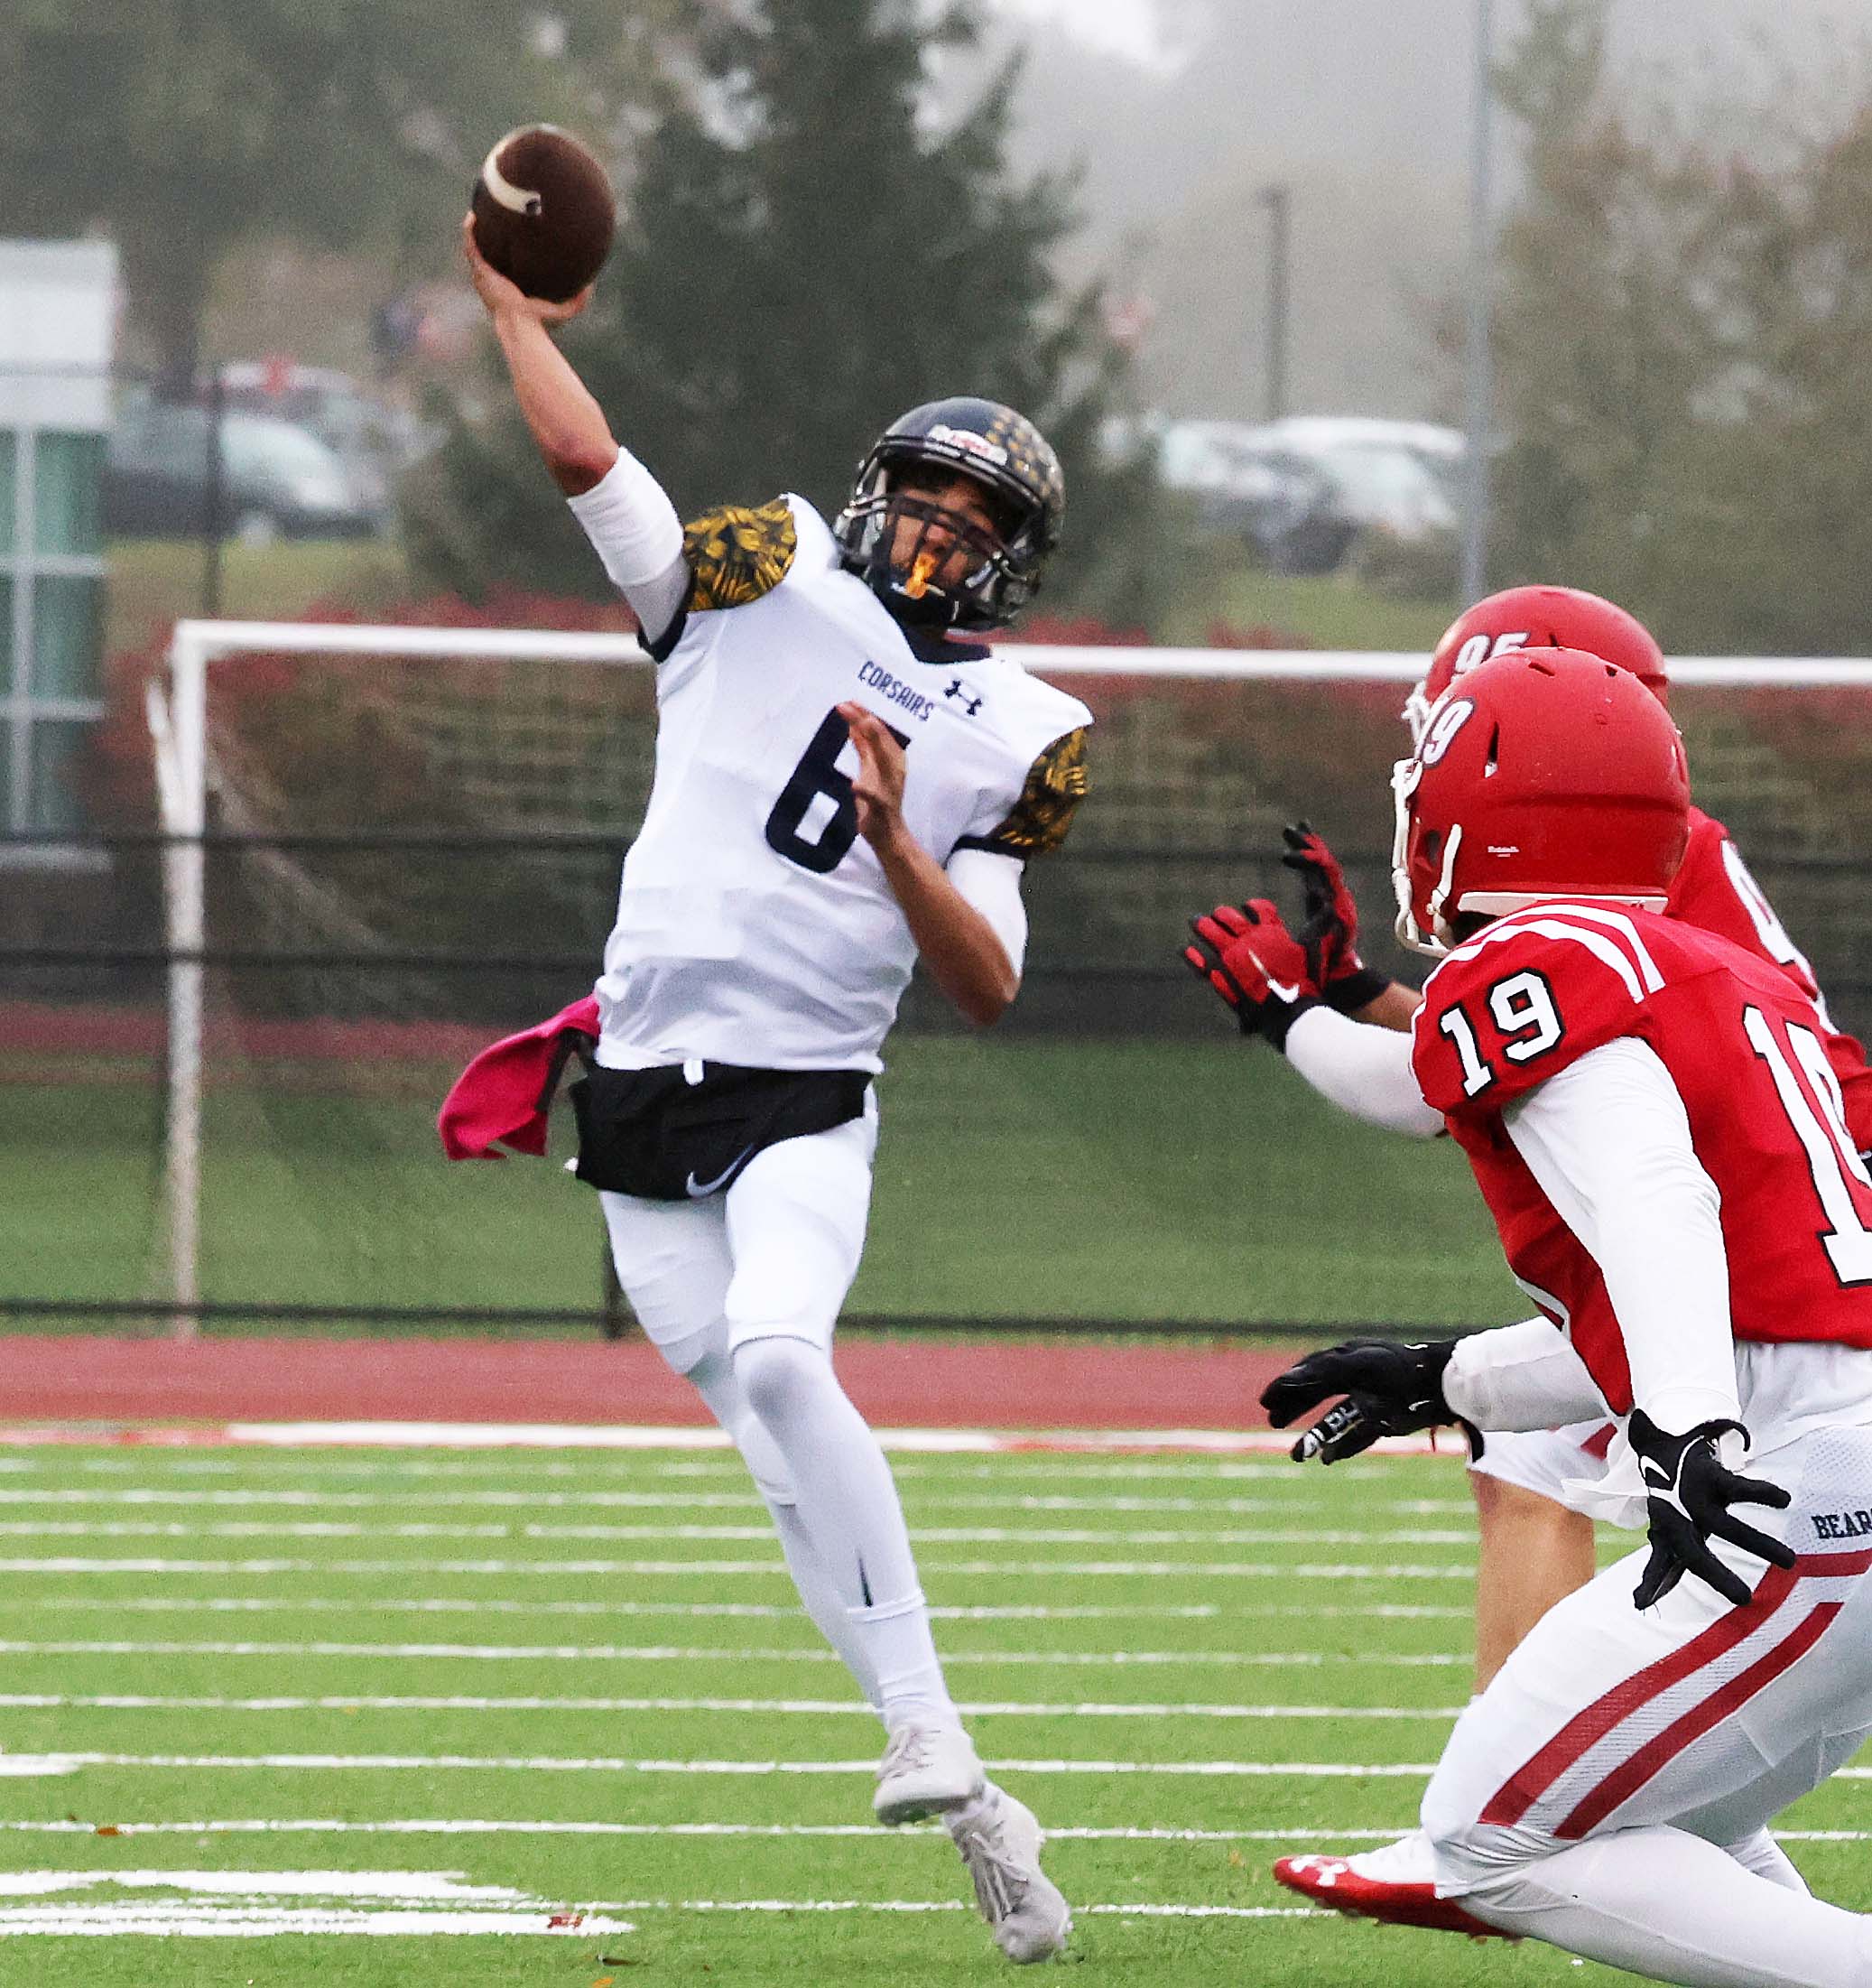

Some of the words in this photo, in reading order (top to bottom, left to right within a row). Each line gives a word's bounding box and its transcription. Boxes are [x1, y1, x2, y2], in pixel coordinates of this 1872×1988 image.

[857, 660, 934, 721] CORSAIRS
[765, 701, 911, 874] 6
[1440, 967, 1565, 1098] 19
[1811, 1509, 1872, 1539] BEAR
